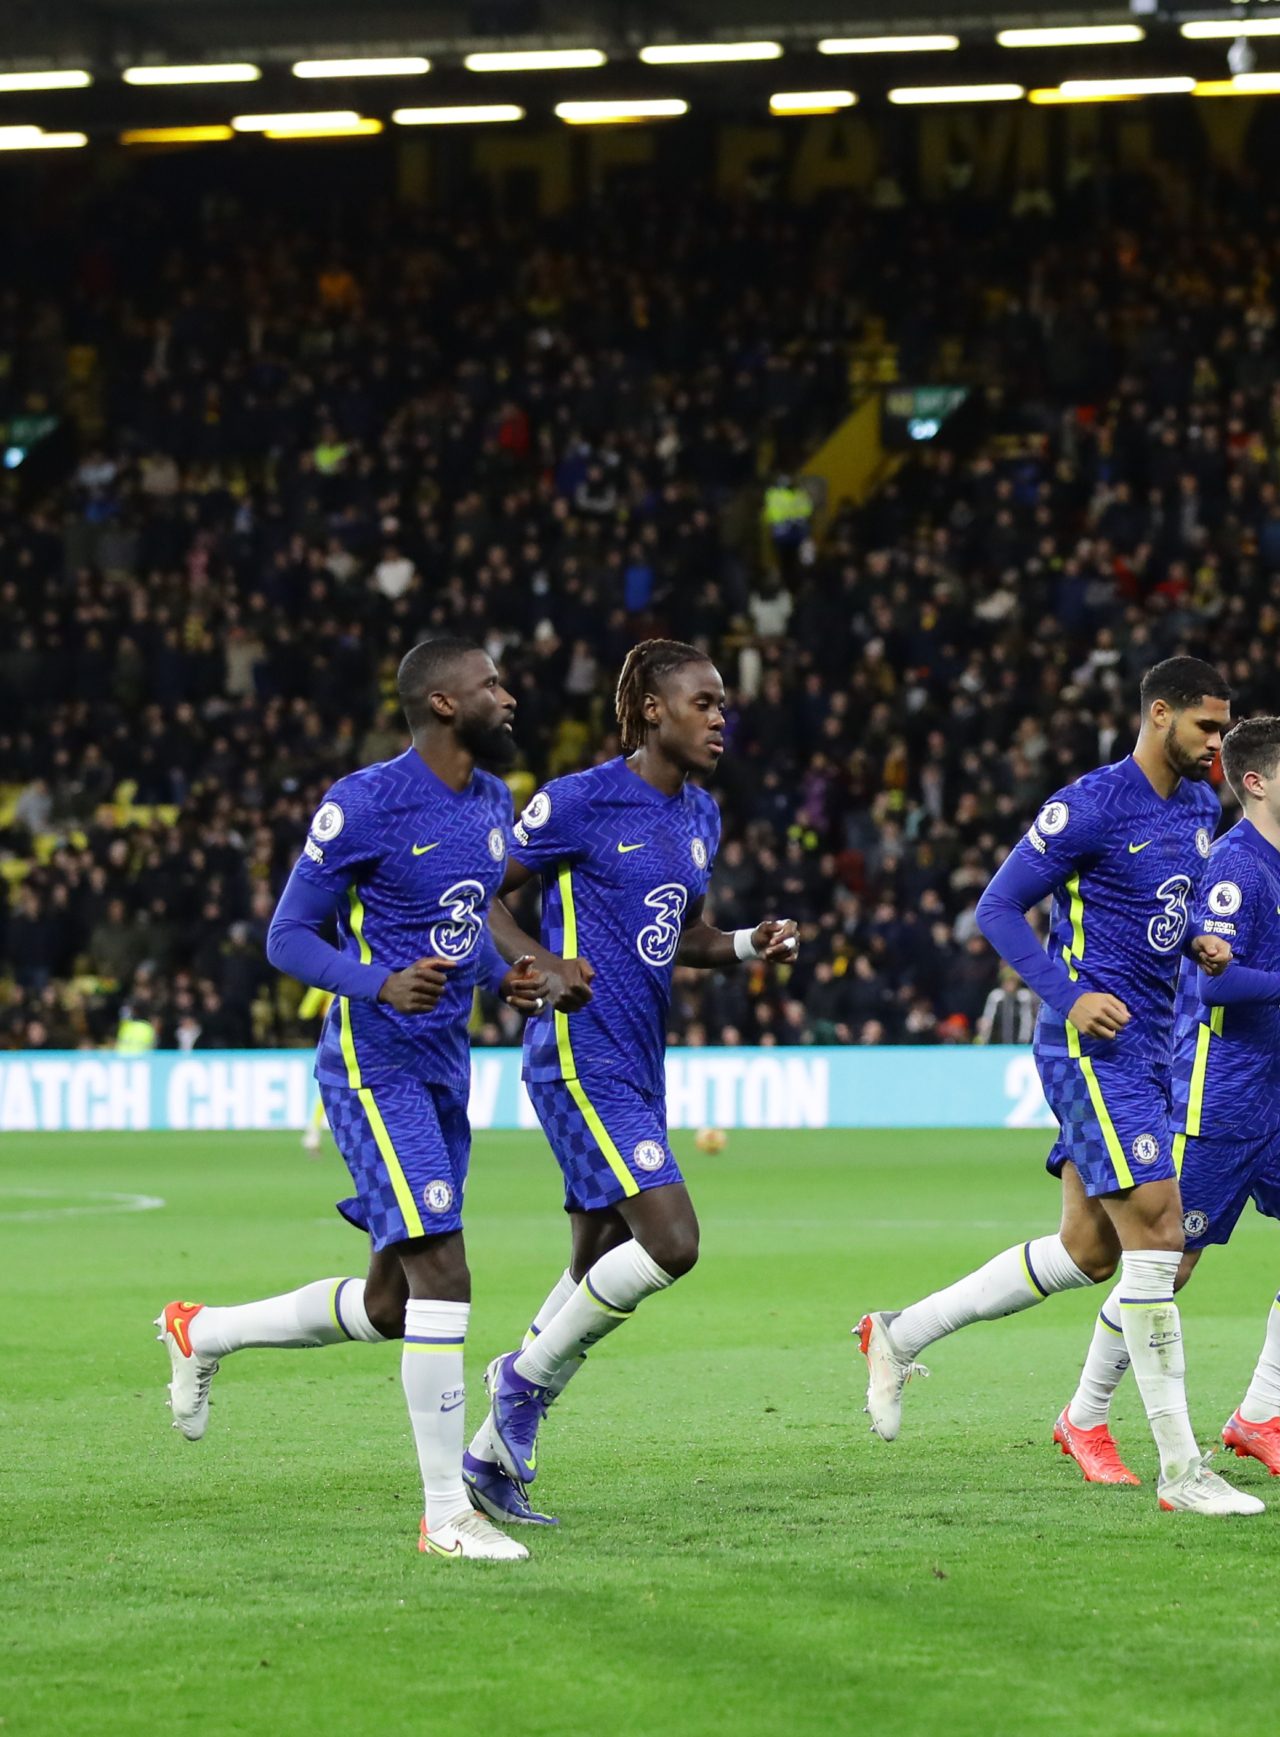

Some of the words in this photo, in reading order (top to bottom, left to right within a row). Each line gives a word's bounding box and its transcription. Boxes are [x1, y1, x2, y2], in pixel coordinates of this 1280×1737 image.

[430, 879, 485, 960] 3
[636, 883, 688, 966] 3
[1147, 874, 1192, 952] 3
[0, 1059, 151, 1129] ATCH
[167, 1059, 328, 1129] CHEL
